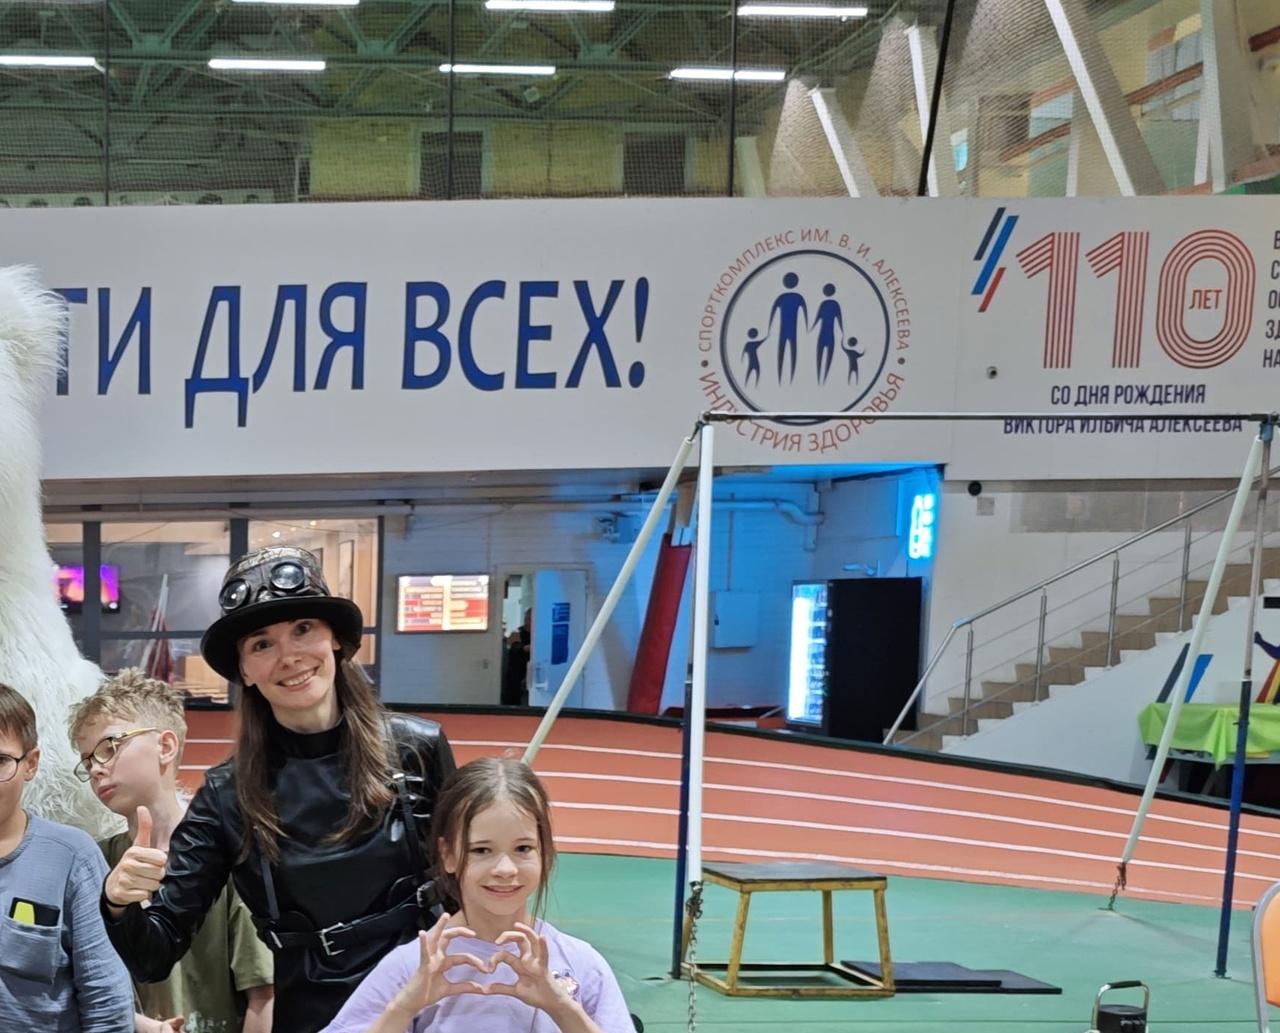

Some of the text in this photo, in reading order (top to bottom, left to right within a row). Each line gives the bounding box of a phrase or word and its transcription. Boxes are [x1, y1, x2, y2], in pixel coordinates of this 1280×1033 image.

[698, 227, 911, 352] СПОРТКОМПЛЕКС ИМ. В. И. АЛЕКСЕЕВА
[1016, 228, 1257, 370] 110
[1188, 289, 1223, 310] ЛЕТ
[184, 281, 369, 430] ДЛЯ
[401, 277, 650, 392] ВСЕХ!
[698, 371, 905, 454] ИНДСТРИЯ ЗДОРОВЬЯ
[1004, 416, 1243, 435] ВИКТОРА ИЛЬИЧА АЛЕКСЕЕВА
[1050, 384, 1206, 407] СО ДНЯ РОЖДЕНИЯ
